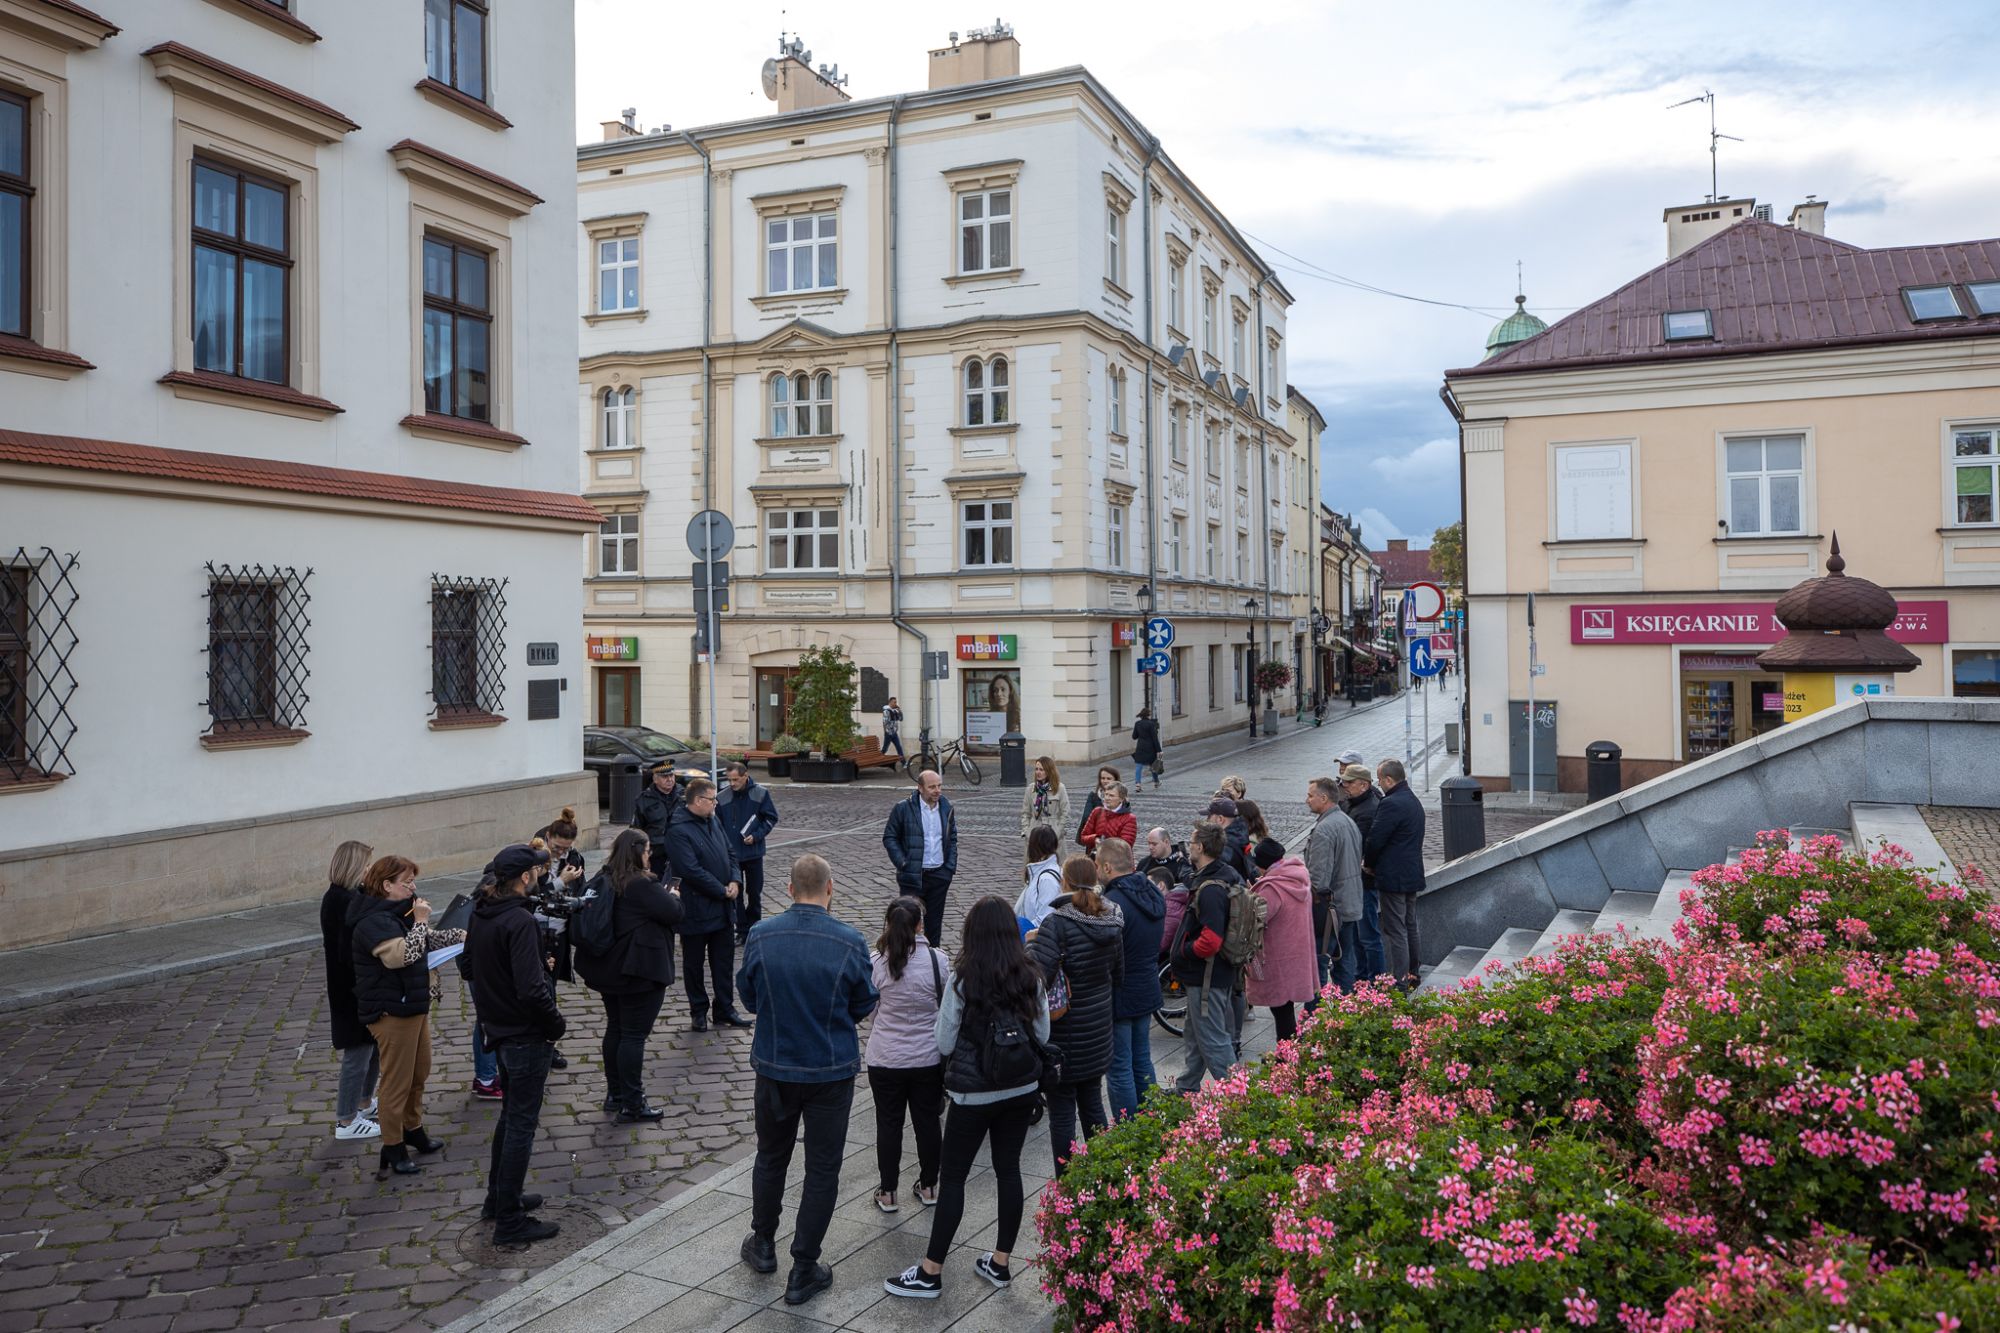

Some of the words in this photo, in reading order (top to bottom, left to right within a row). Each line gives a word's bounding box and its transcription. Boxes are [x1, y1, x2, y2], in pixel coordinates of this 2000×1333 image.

[1590, 612, 1605, 628] N
[1626, 615, 1760, 636] KSIĘGARNIE
[592, 642, 630, 654] mBank
[962, 641, 1009, 653] mBank
[1437, 636, 1449, 649] N
[530, 647, 556, 660] RYNEK
